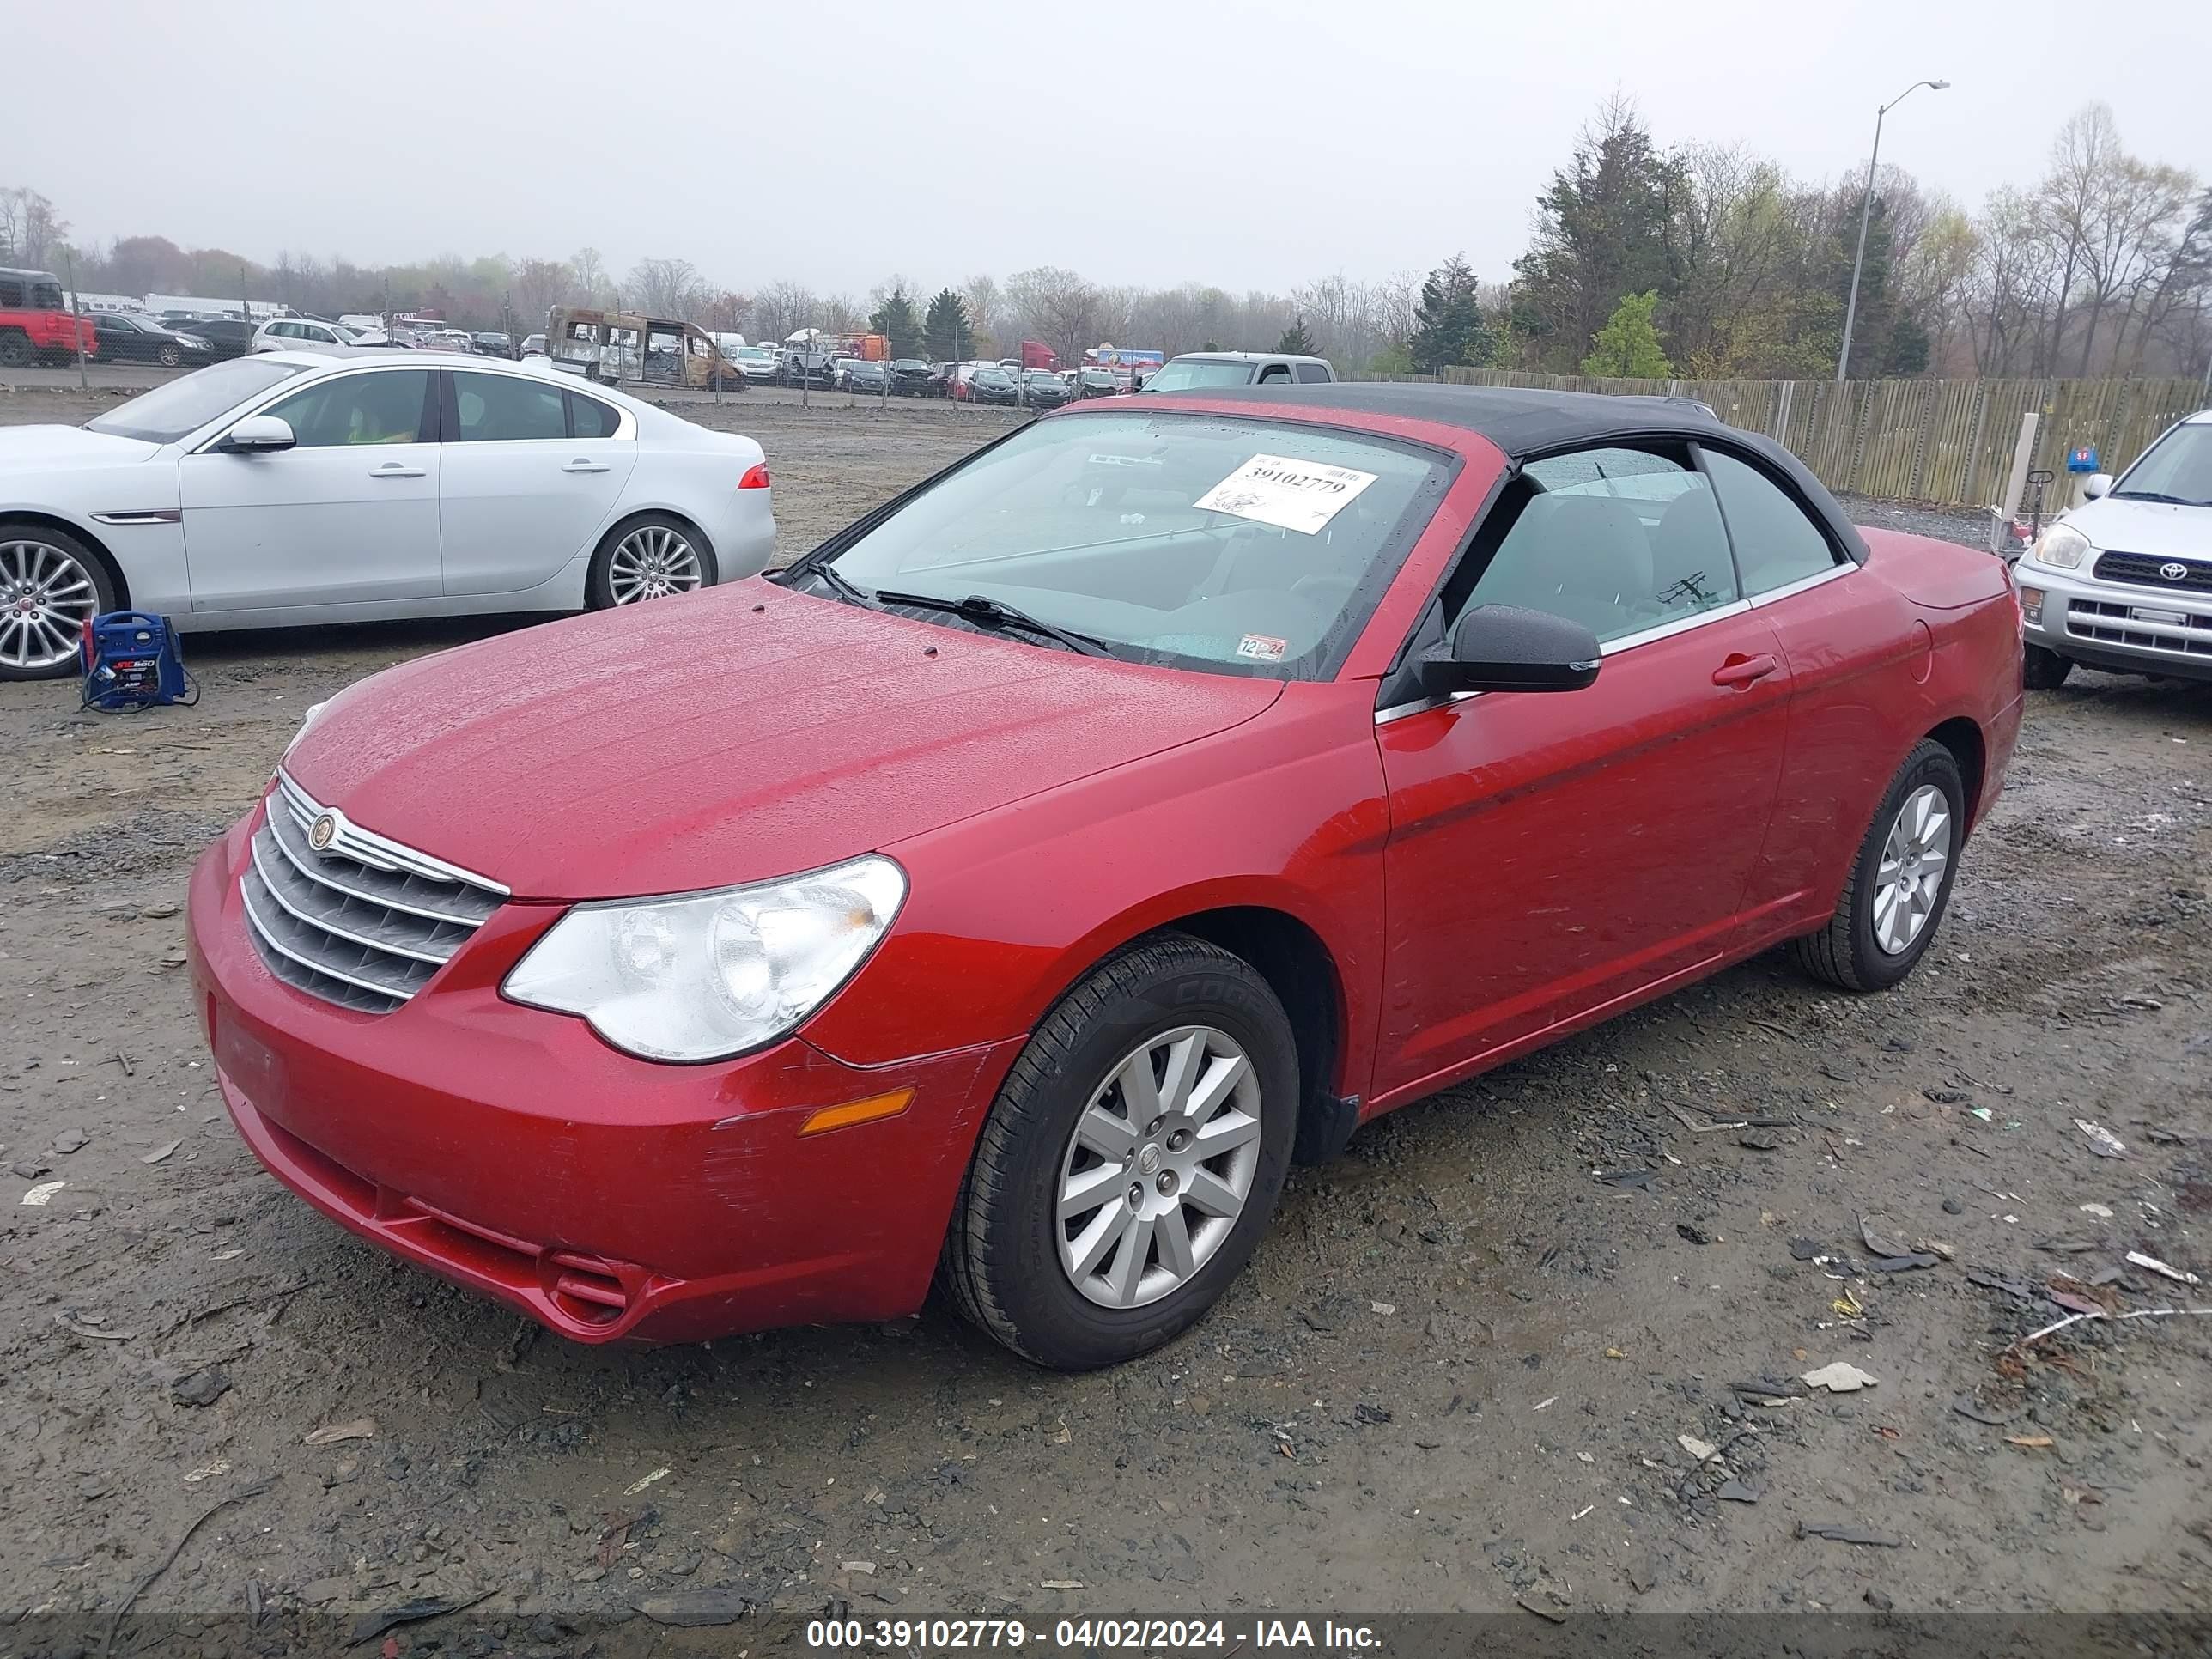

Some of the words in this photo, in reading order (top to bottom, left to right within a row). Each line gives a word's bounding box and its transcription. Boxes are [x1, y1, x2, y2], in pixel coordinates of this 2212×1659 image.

[1244, 467, 1346, 494] 39102779
[1241, 640, 1257, 653] 12
[1269, 641, 1285, 654] 24
